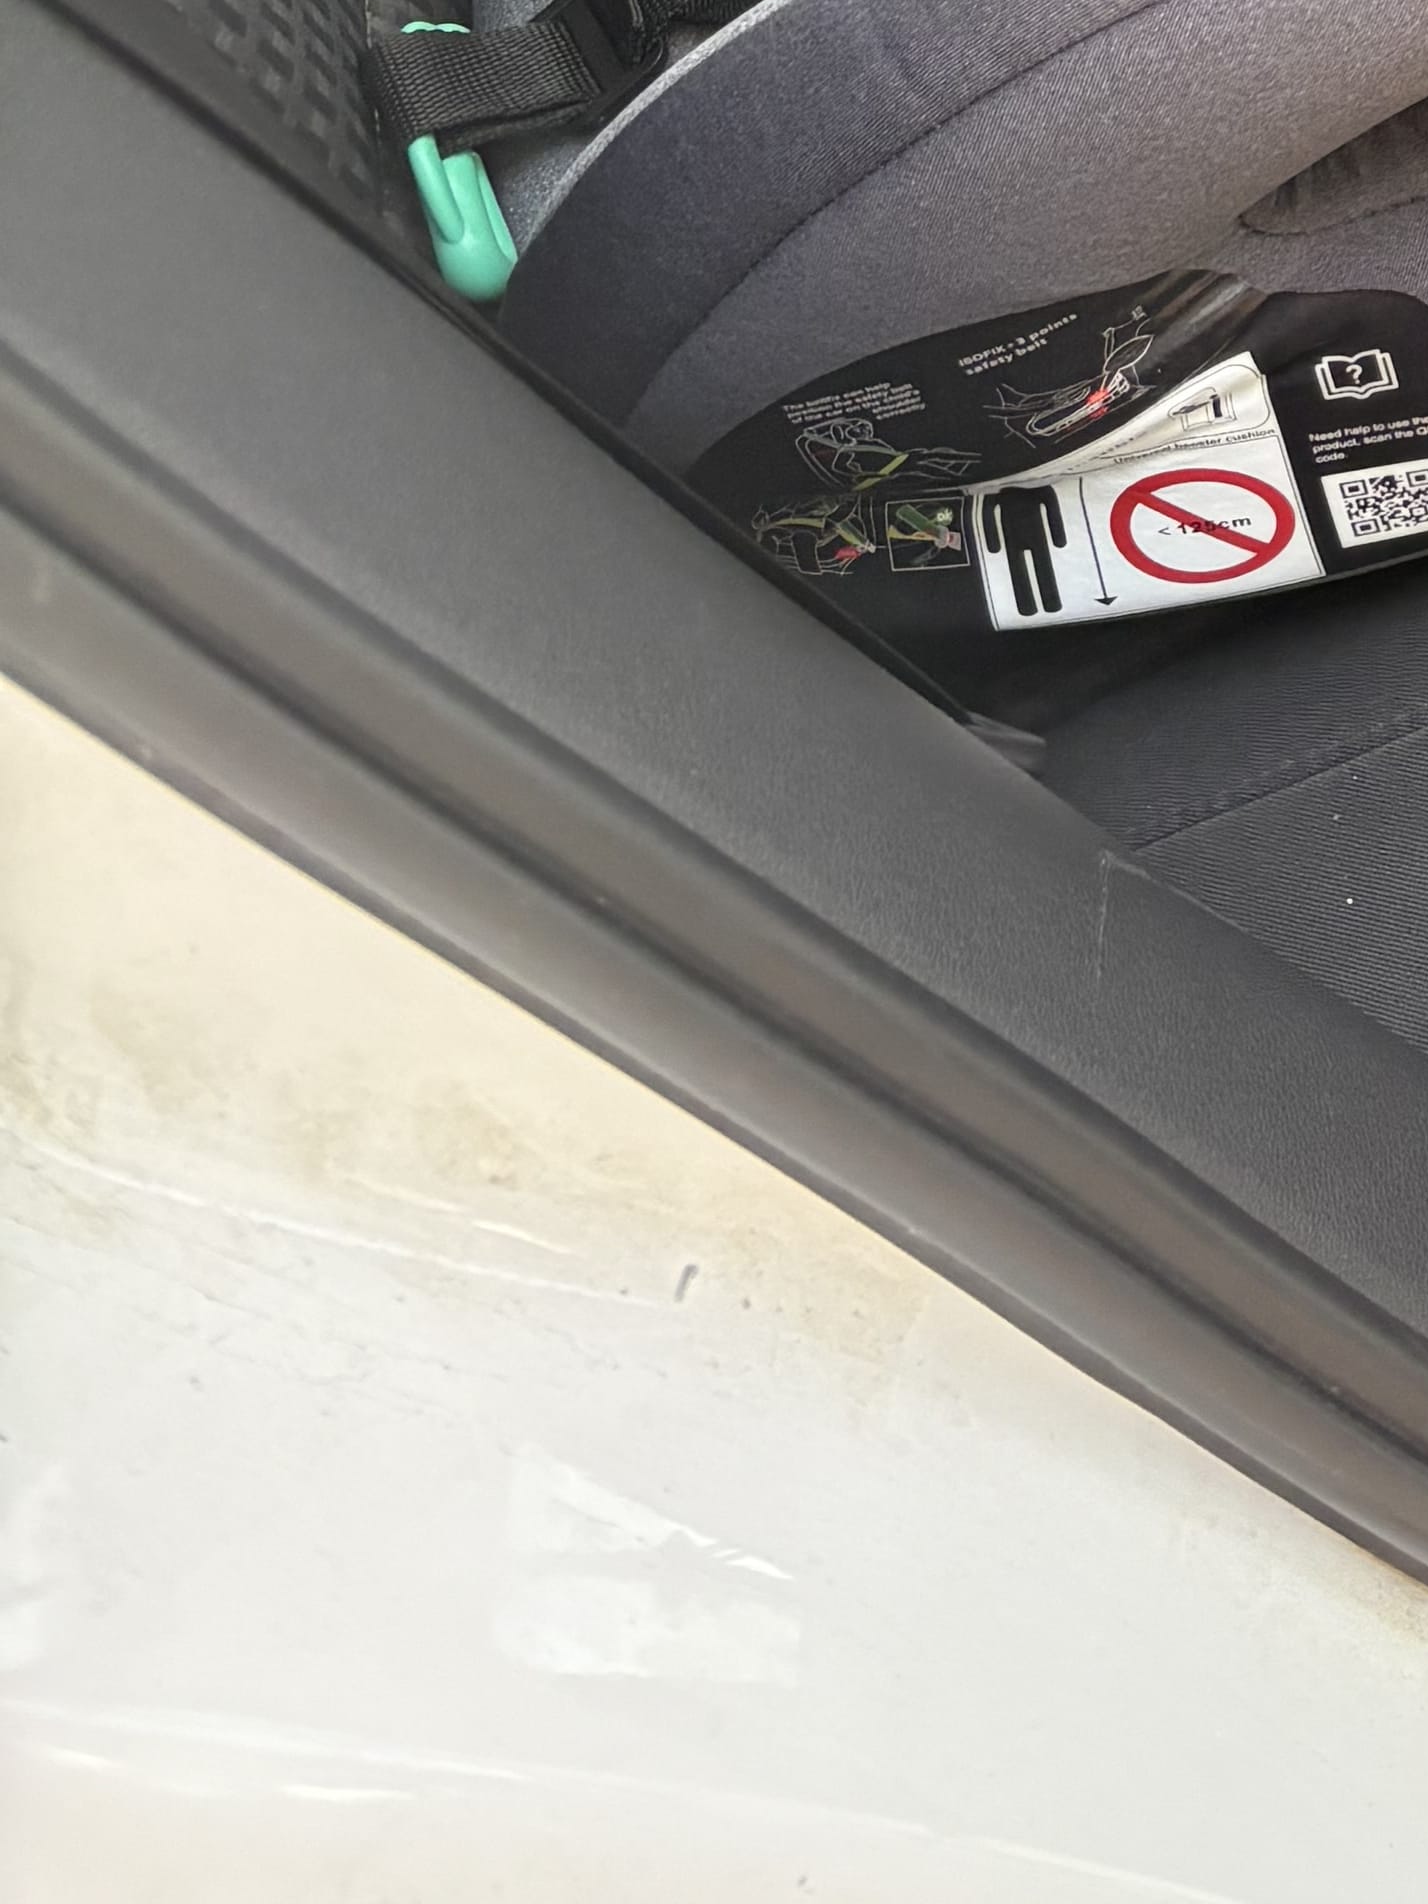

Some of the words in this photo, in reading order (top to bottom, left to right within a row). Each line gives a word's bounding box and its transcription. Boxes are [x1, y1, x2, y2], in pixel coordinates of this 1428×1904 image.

[1029, 314, 1077, 341] points
[965, 354, 1013, 375] safety
[1015, 338, 1048, 357] belt
[1226, 429, 1276, 444] cushion
[1308, 429, 1342, 442] Need
[1344, 425, 1371, 437] help
[1373, 423, 1385, 432] to
[1387, 419, 1410, 430] use
[1363, 433, 1392, 444] scan
[1394, 430, 1414, 439] the
